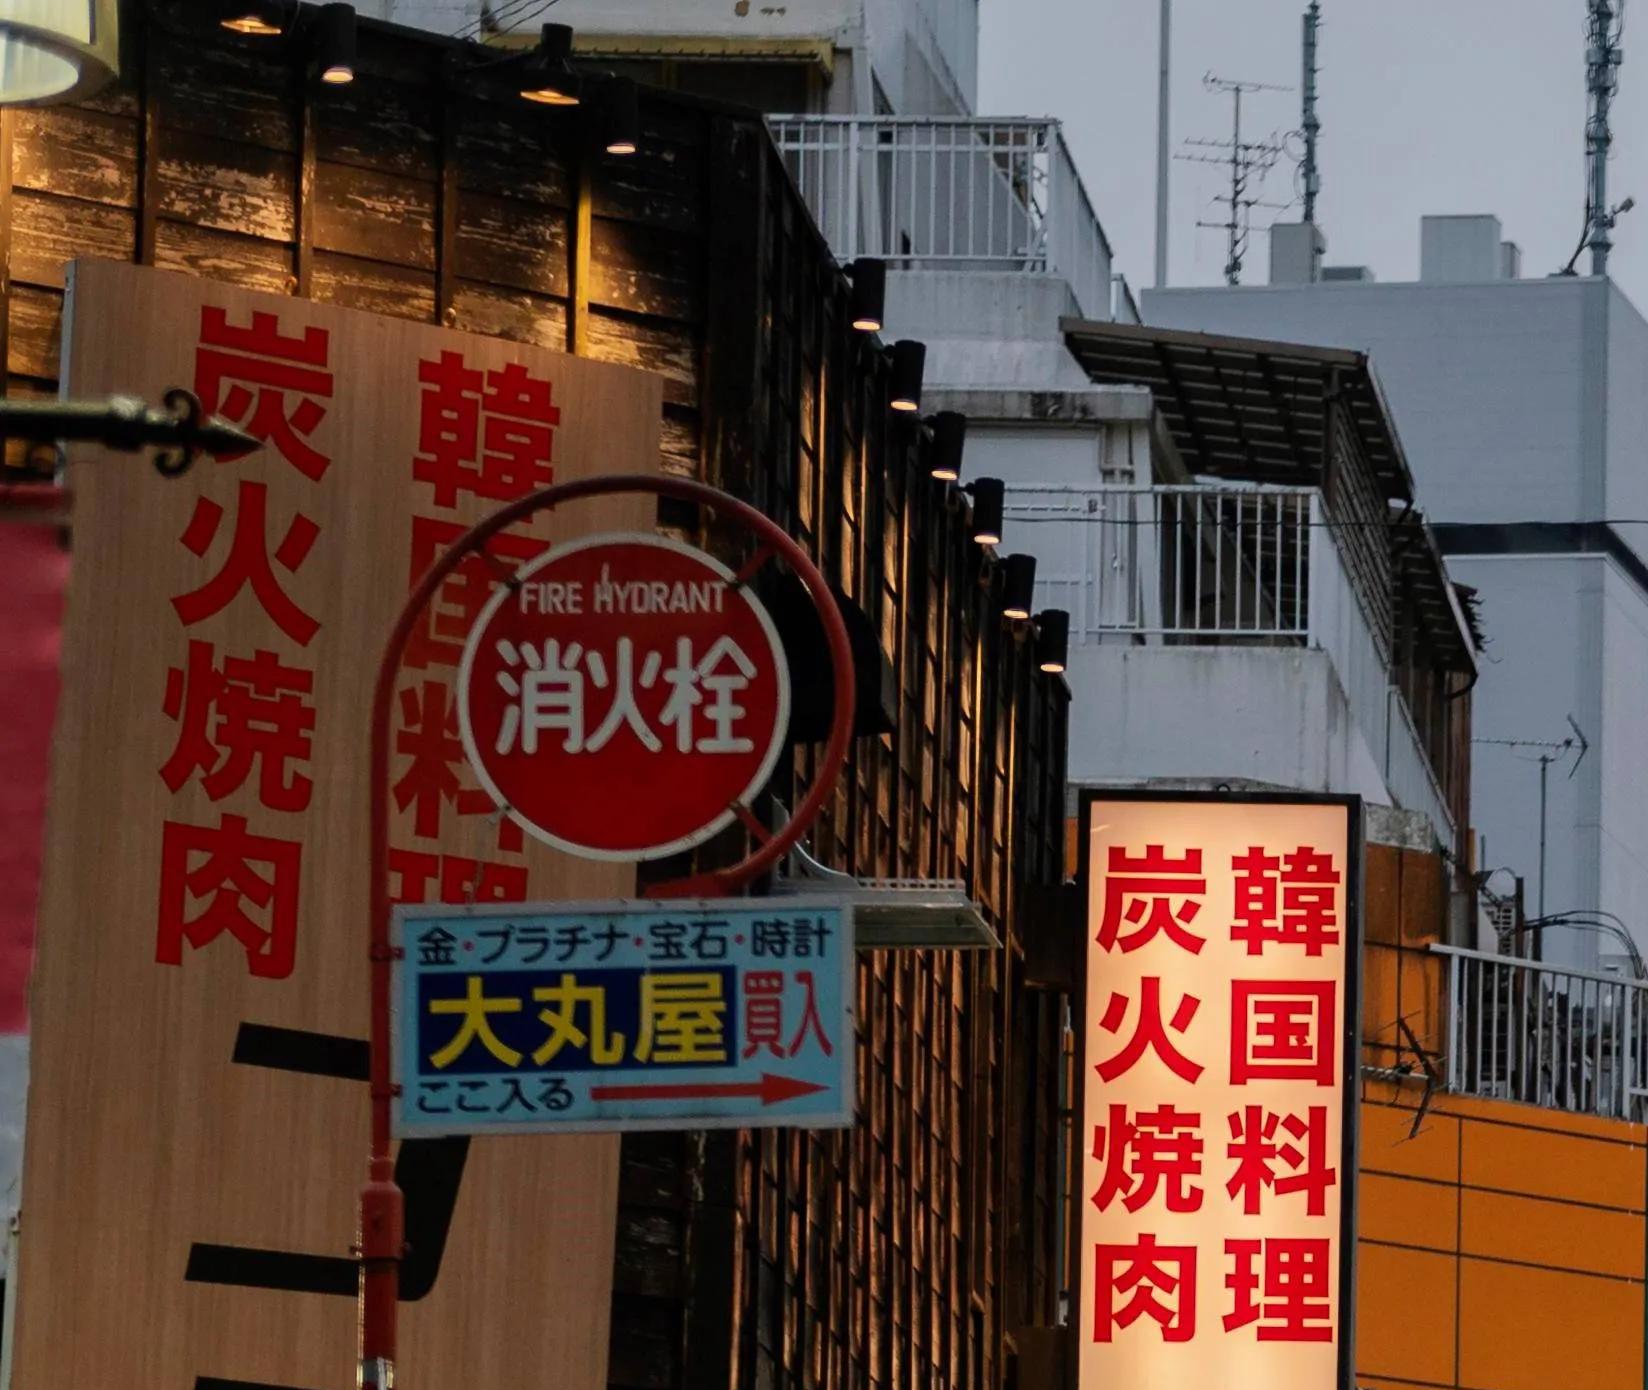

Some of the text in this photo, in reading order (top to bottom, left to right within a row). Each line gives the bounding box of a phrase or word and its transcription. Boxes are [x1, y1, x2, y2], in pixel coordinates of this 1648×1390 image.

[156, 305, 335, 980] 炭火焼肉
[520, 579, 729, 614] FIRE HYDRANT
[496, 635, 757, 756] 消火栓
[428, 970, 833, 1068] 大丸屋 買入
[415, 1076, 575, 1114] ここ入る
[1091, 844, 1208, 1344] 炭火焼肉
[1222, 846, 1341, 1344] 韓国料理
